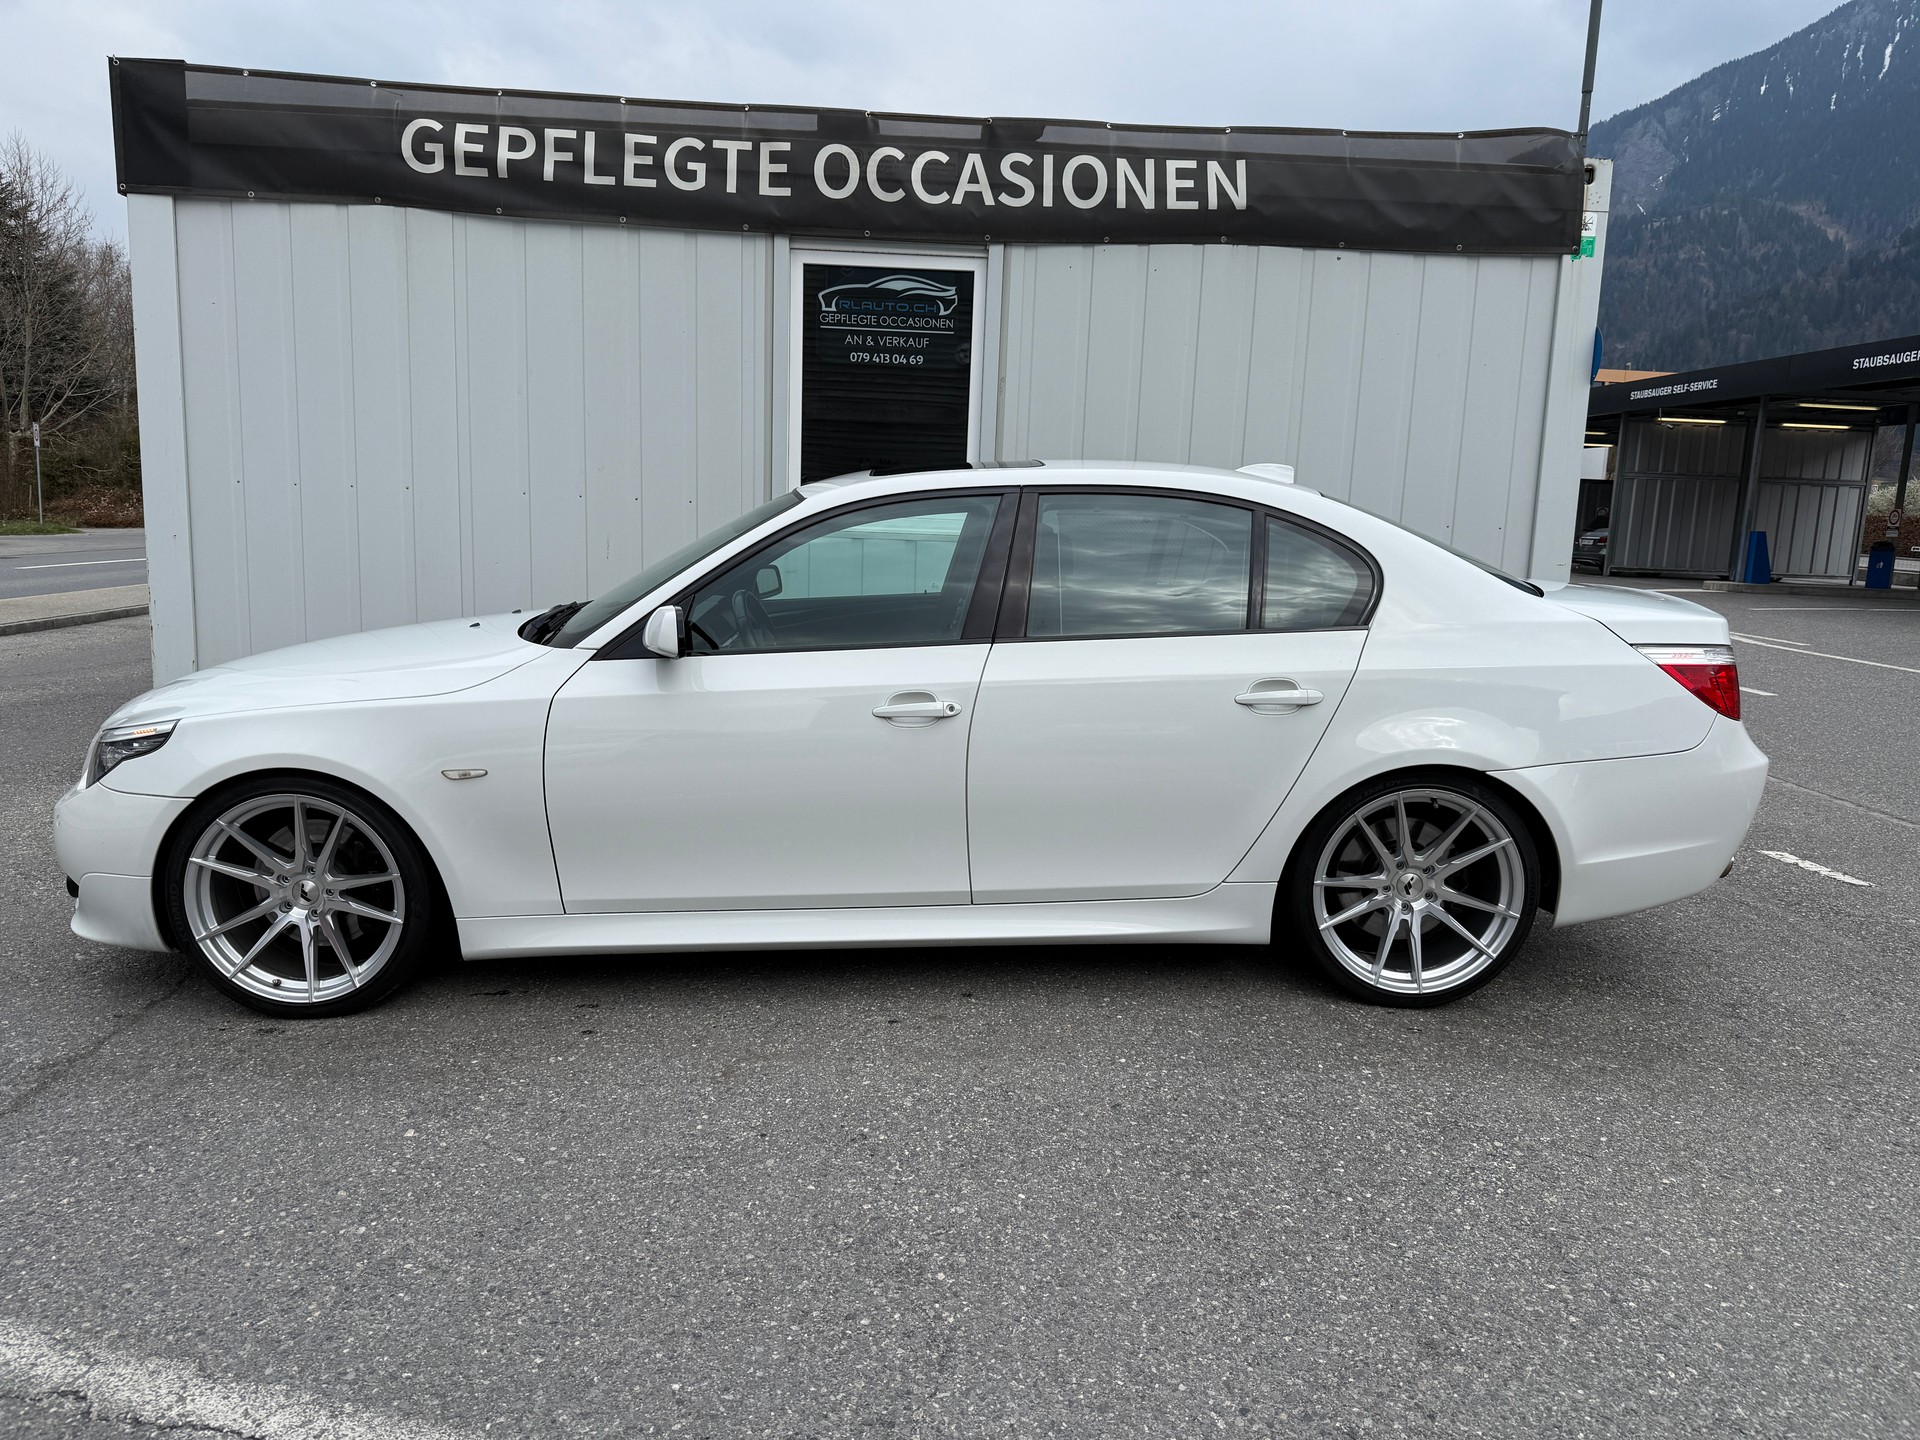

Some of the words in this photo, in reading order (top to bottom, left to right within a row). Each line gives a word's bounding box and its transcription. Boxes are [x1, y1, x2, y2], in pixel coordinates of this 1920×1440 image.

[401, 118, 792, 197] GEPFLEGTE
[814, 143, 1247, 211] OCCASIONEN
[819, 313, 878, 325] GEPFLEGTE
[879, 315, 954, 328] OCCASIONEN
[845, 334, 862, 344] AN
[866, 335, 875, 346] &
[877, 336, 930, 348] VERKAUF
[849, 352, 870, 363] 079
[872, 353, 890, 364] 413
[892, 354, 907, 365] 04
[909, 355, 924, 365] 69
[1630, 385, 1672, 400] STAUBSAUGER
[1672, 379, 1718, 394] SELF-SERVICE
